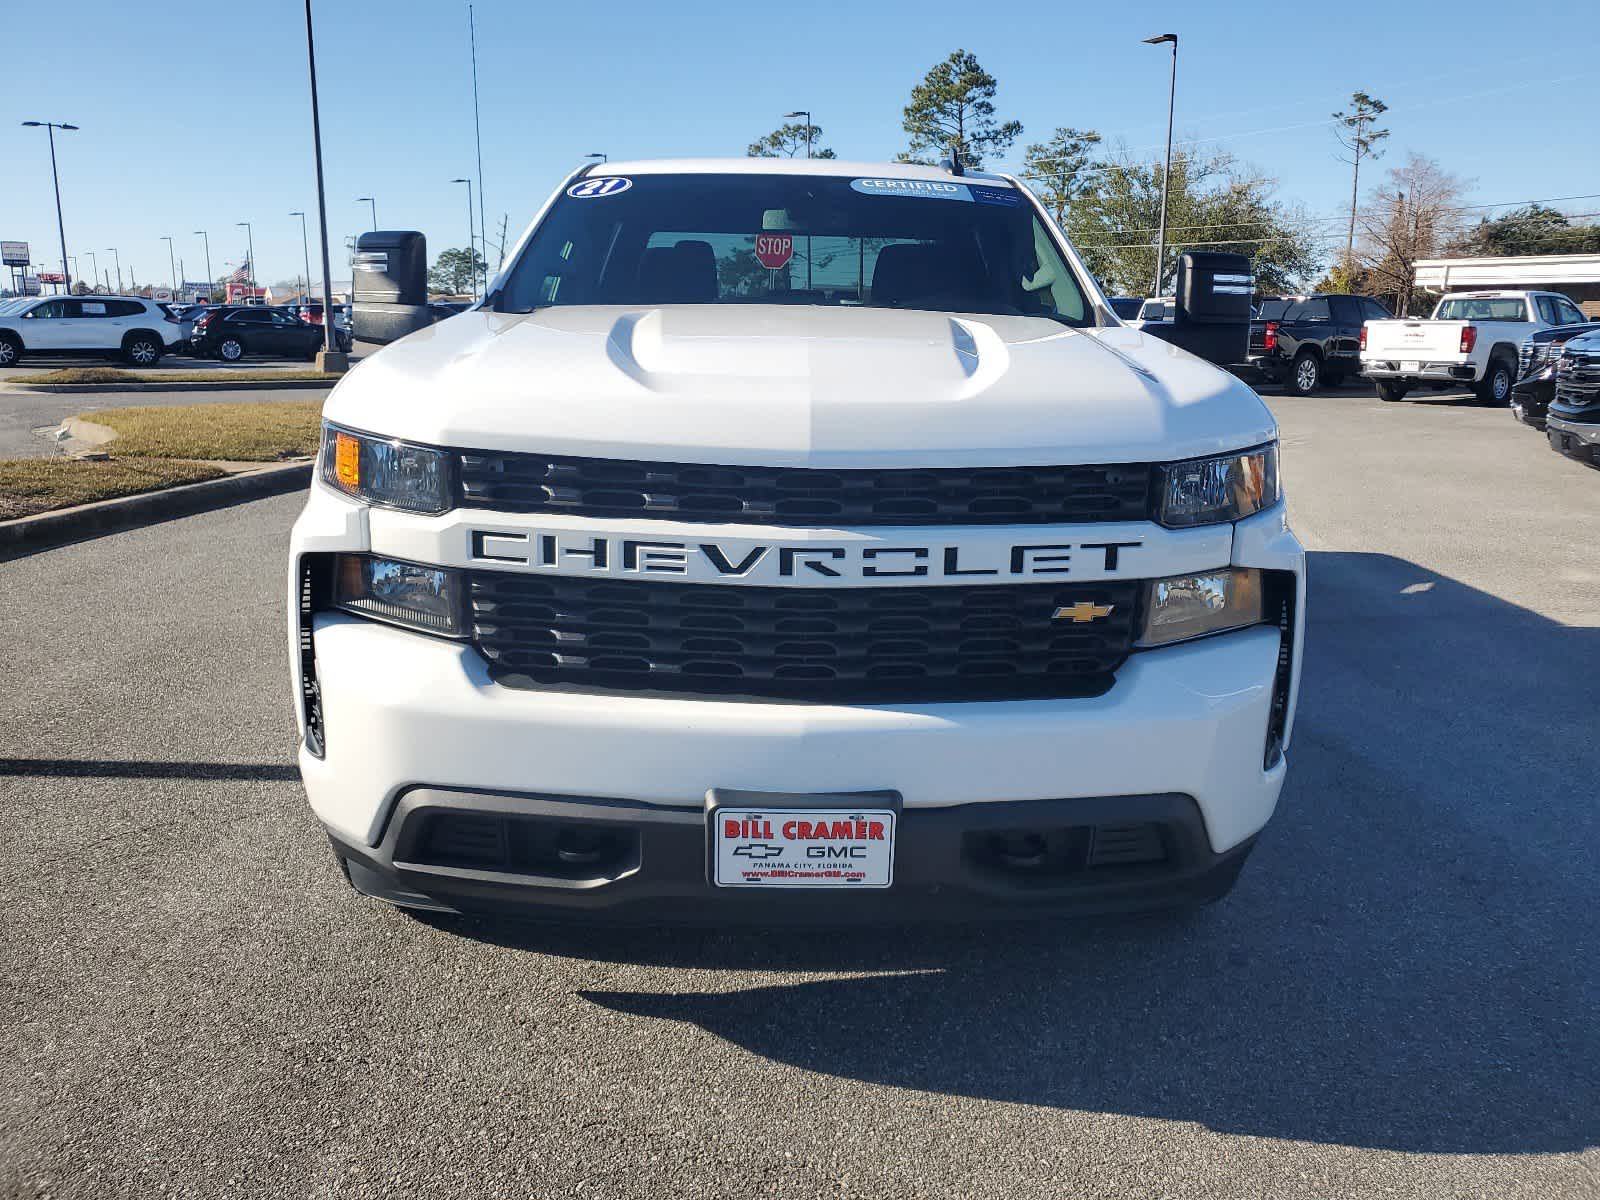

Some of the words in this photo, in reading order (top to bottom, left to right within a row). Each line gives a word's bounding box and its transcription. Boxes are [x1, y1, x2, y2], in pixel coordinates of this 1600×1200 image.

[576, 179, 620, 196] 21
[861, 180, 958, 193] CERTIFIED
[757, 237, 792, 255] STOP
[470, 529, 1143, 577] CHEVROLET
[724, 820, 774, 839] BILL
[782, 821, 885, 840] CRAMER
[806, 846, 867, 858] GMC
[794, 862, 814, 870] CITY,
